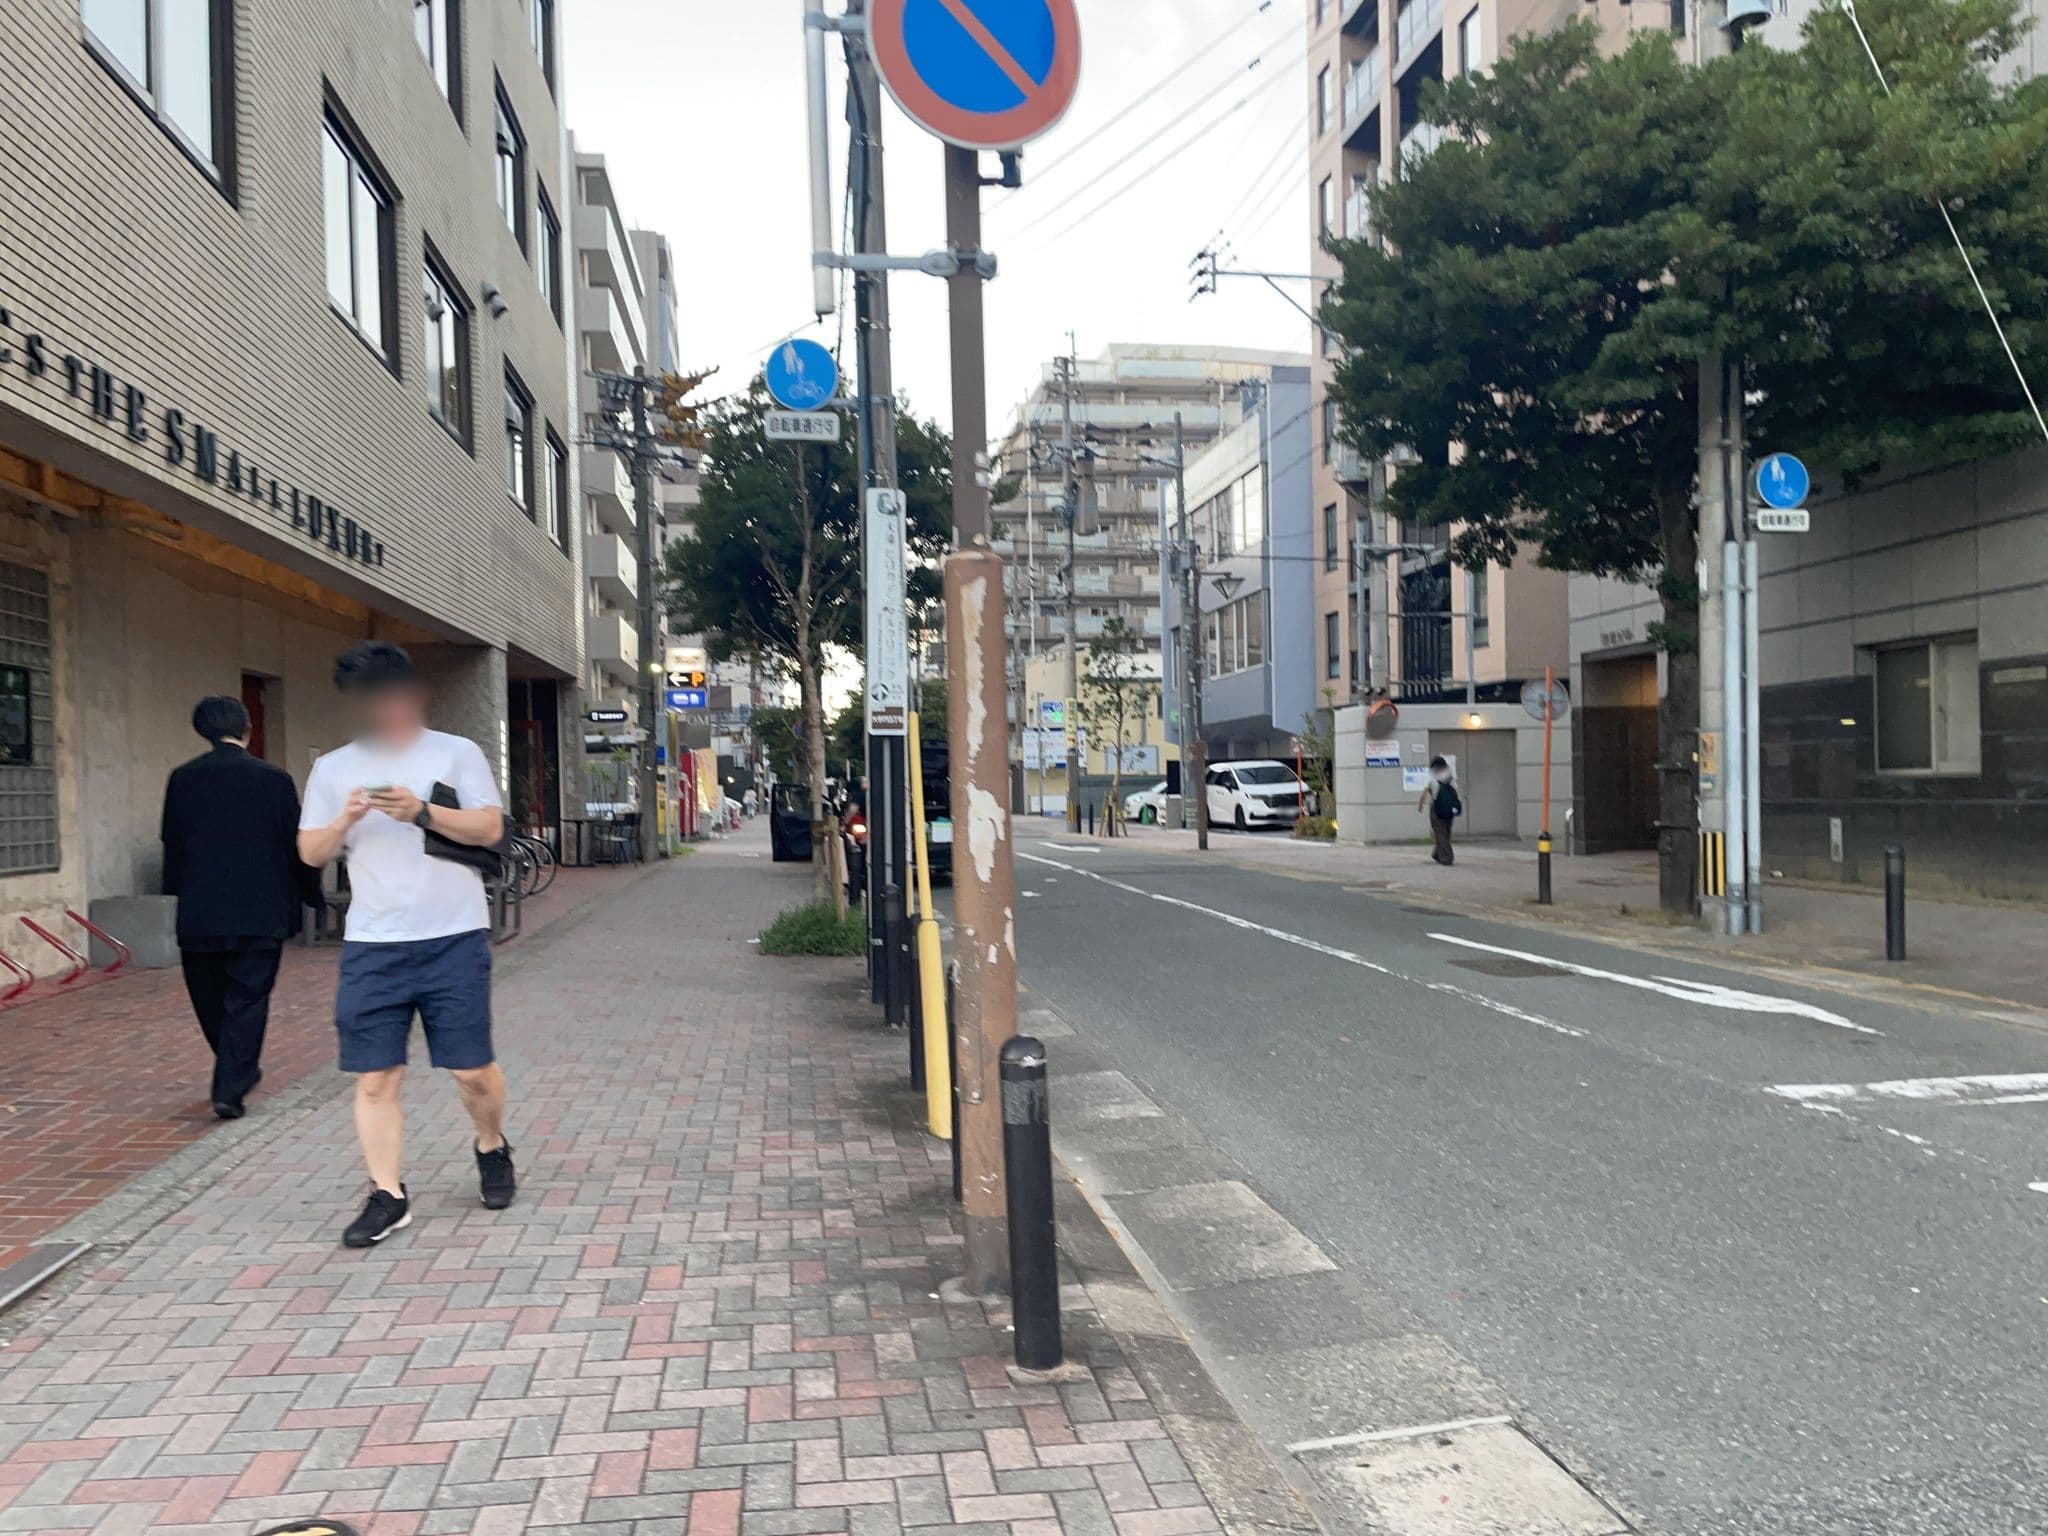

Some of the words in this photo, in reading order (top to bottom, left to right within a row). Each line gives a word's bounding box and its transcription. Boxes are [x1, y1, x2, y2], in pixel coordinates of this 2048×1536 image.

[64, 354, 149, 442] THE
[165, 408, 283, 511] SMALL
[291, 487, 385, 567] LUXURY
